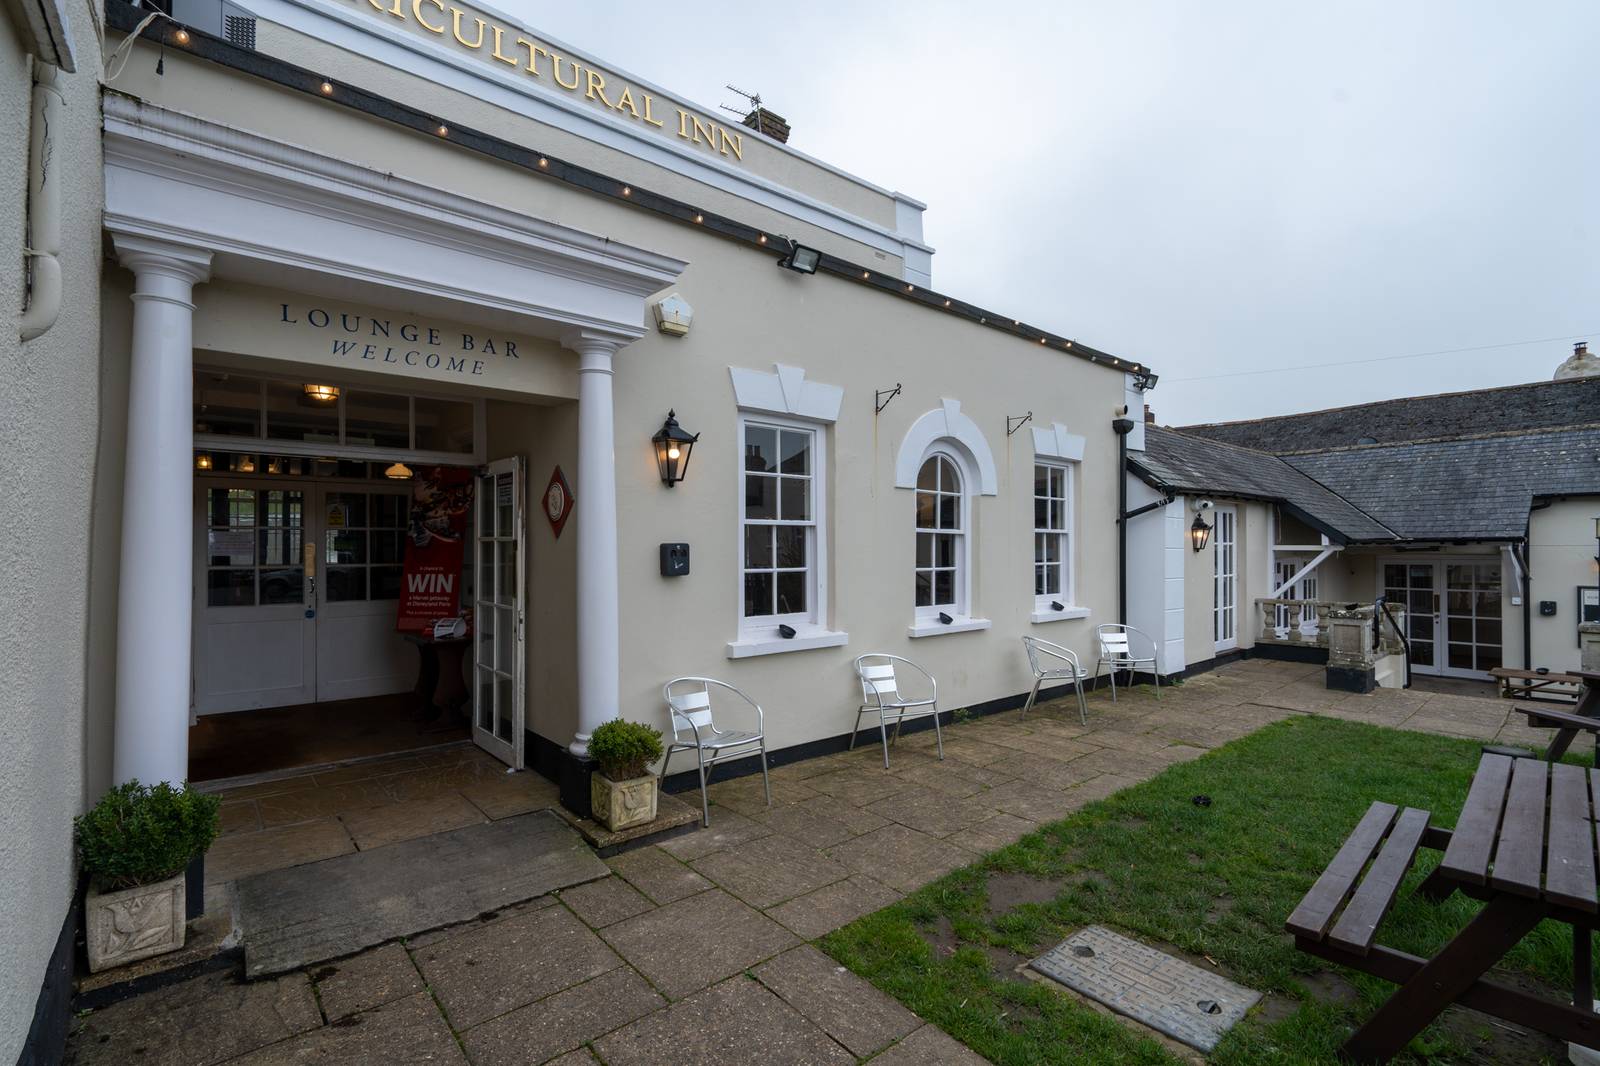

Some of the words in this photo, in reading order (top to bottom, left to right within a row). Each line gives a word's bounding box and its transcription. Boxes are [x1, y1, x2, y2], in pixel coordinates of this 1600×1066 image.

[367, 0, 663, 127] CULTURAL
[676, 108, 743, 161] INN
[280, 303, 442, 346] LOUNGE
[461, 333, 520, 359] BAR
[331, 339, 485, 375] WELCOME
[407, 573, 454, 593] WIN
